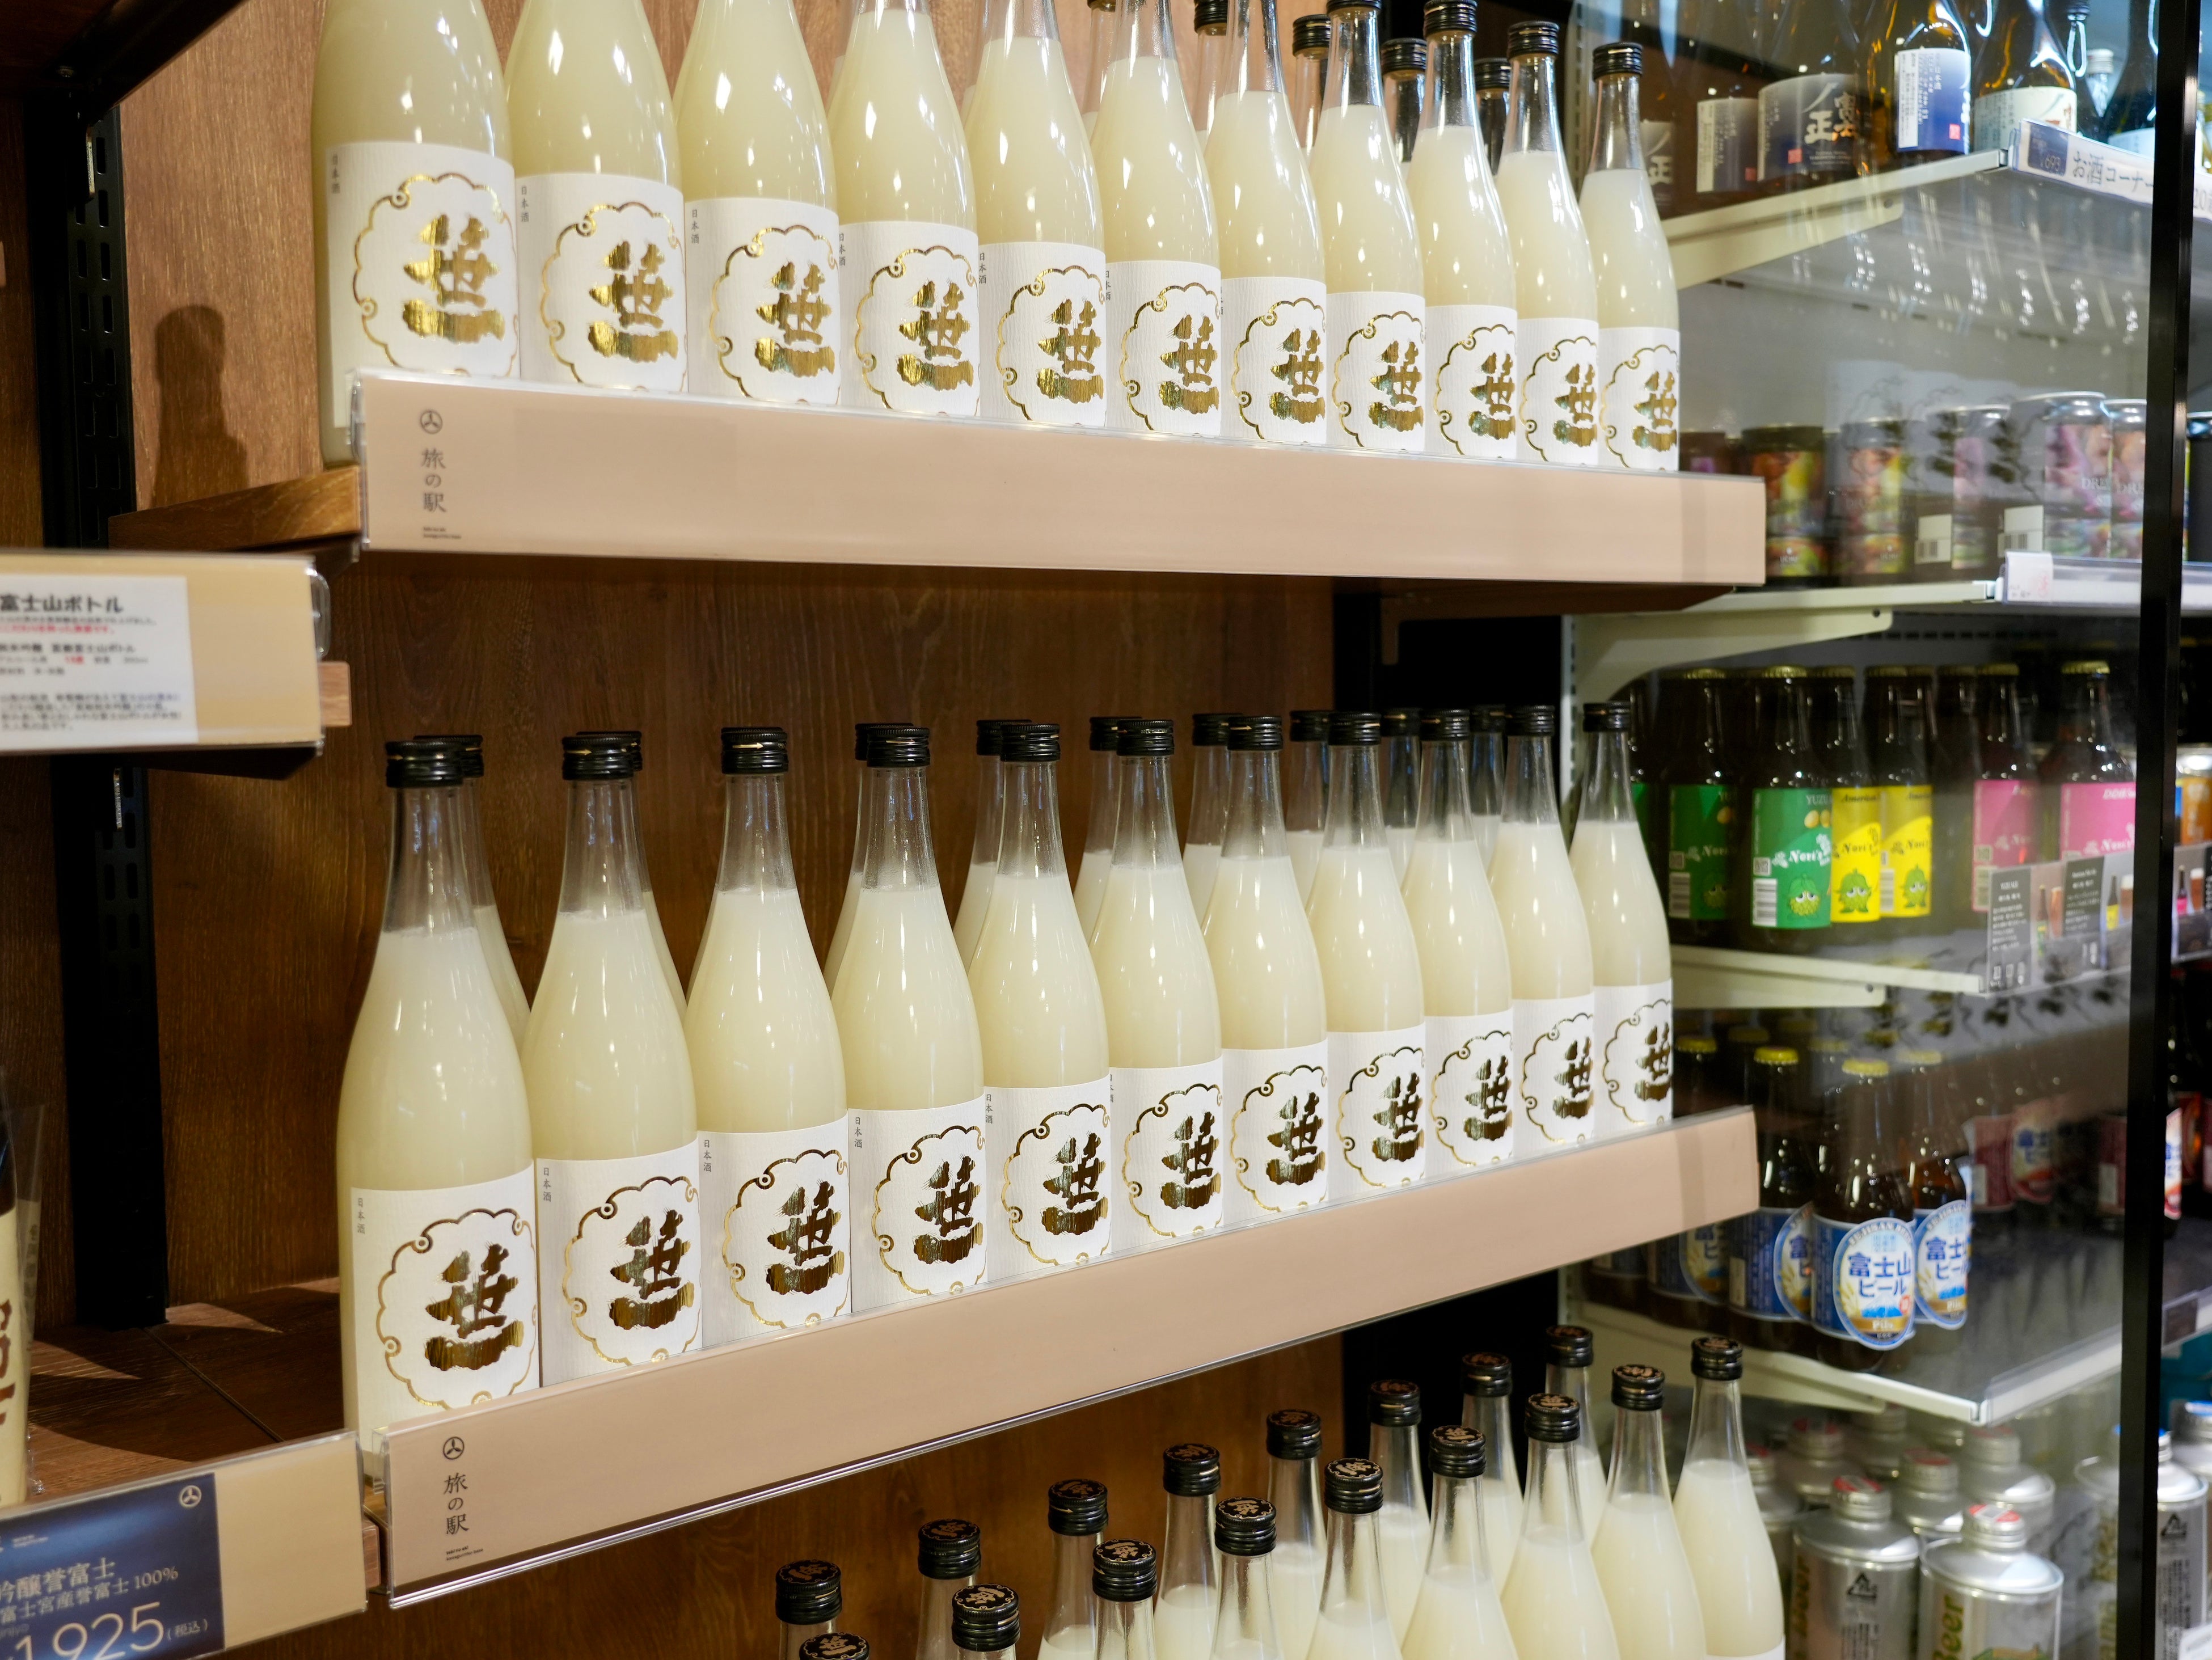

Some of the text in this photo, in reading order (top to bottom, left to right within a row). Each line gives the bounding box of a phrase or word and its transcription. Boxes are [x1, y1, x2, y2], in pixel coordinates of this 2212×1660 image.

[521, 186, 529, 222] 日本酒
[421, 447, 447, 513] 旅の駅
[543, 1167, 552, 1202] 日本酒
[357, 1197, 366, 1234] 日本酒
[1847, 1251, 1911, 1278] 富士山
[1860, 1277, 1907, 1298] ビール
[444, 1472, 470, 1535] 旅の駅
[134, 1565, 179, 1590] 100%
[15, 1601, 164, 1660] 1925
